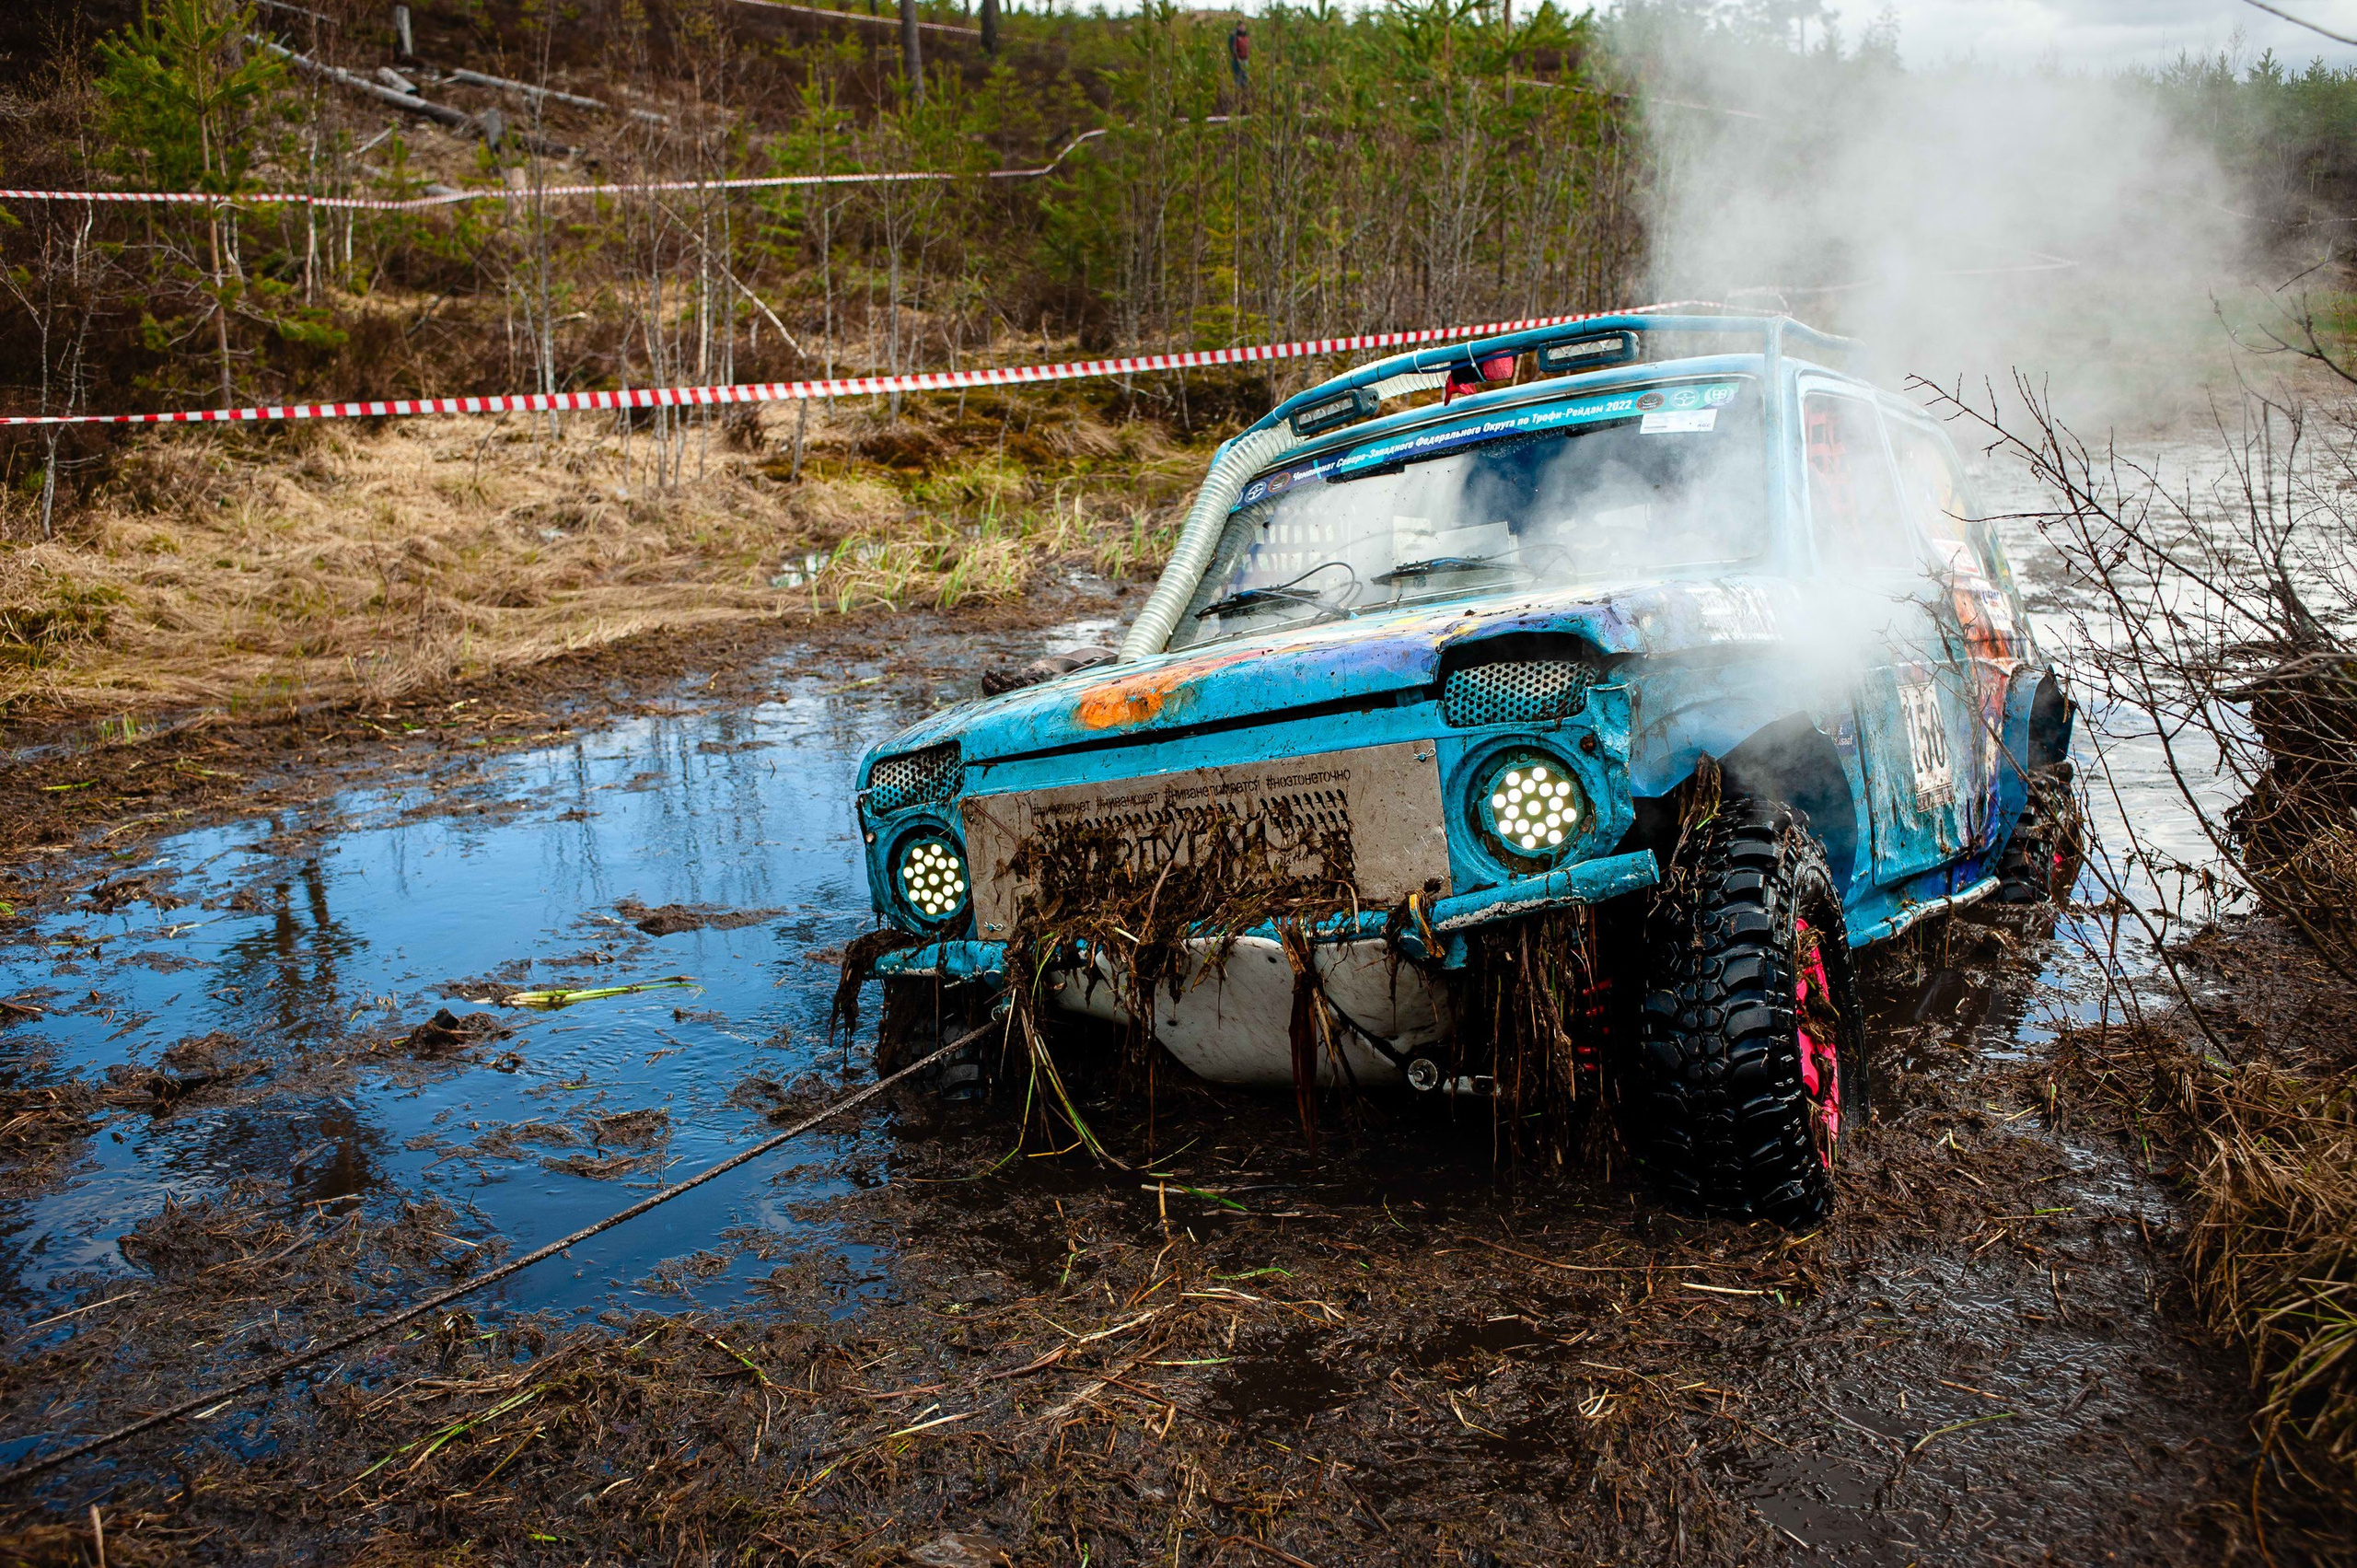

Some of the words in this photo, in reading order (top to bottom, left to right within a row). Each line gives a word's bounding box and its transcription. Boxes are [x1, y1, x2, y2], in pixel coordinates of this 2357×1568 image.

[1293, 462, 1336, 482] Чемпионат
[1336, 442, 1415, 468] Северо-Западного
[1416, 424, 1481, 447] Федерального
[1482, 419, 1515, 433] Округа
[1517, 416, 1529, 425] по
[1532, 406, 1604, 424] Трофи-Рейдам
[1605, 399, 1632, 412] 2022
[1266, 768, 1351, 791] #ноэтонеточно
